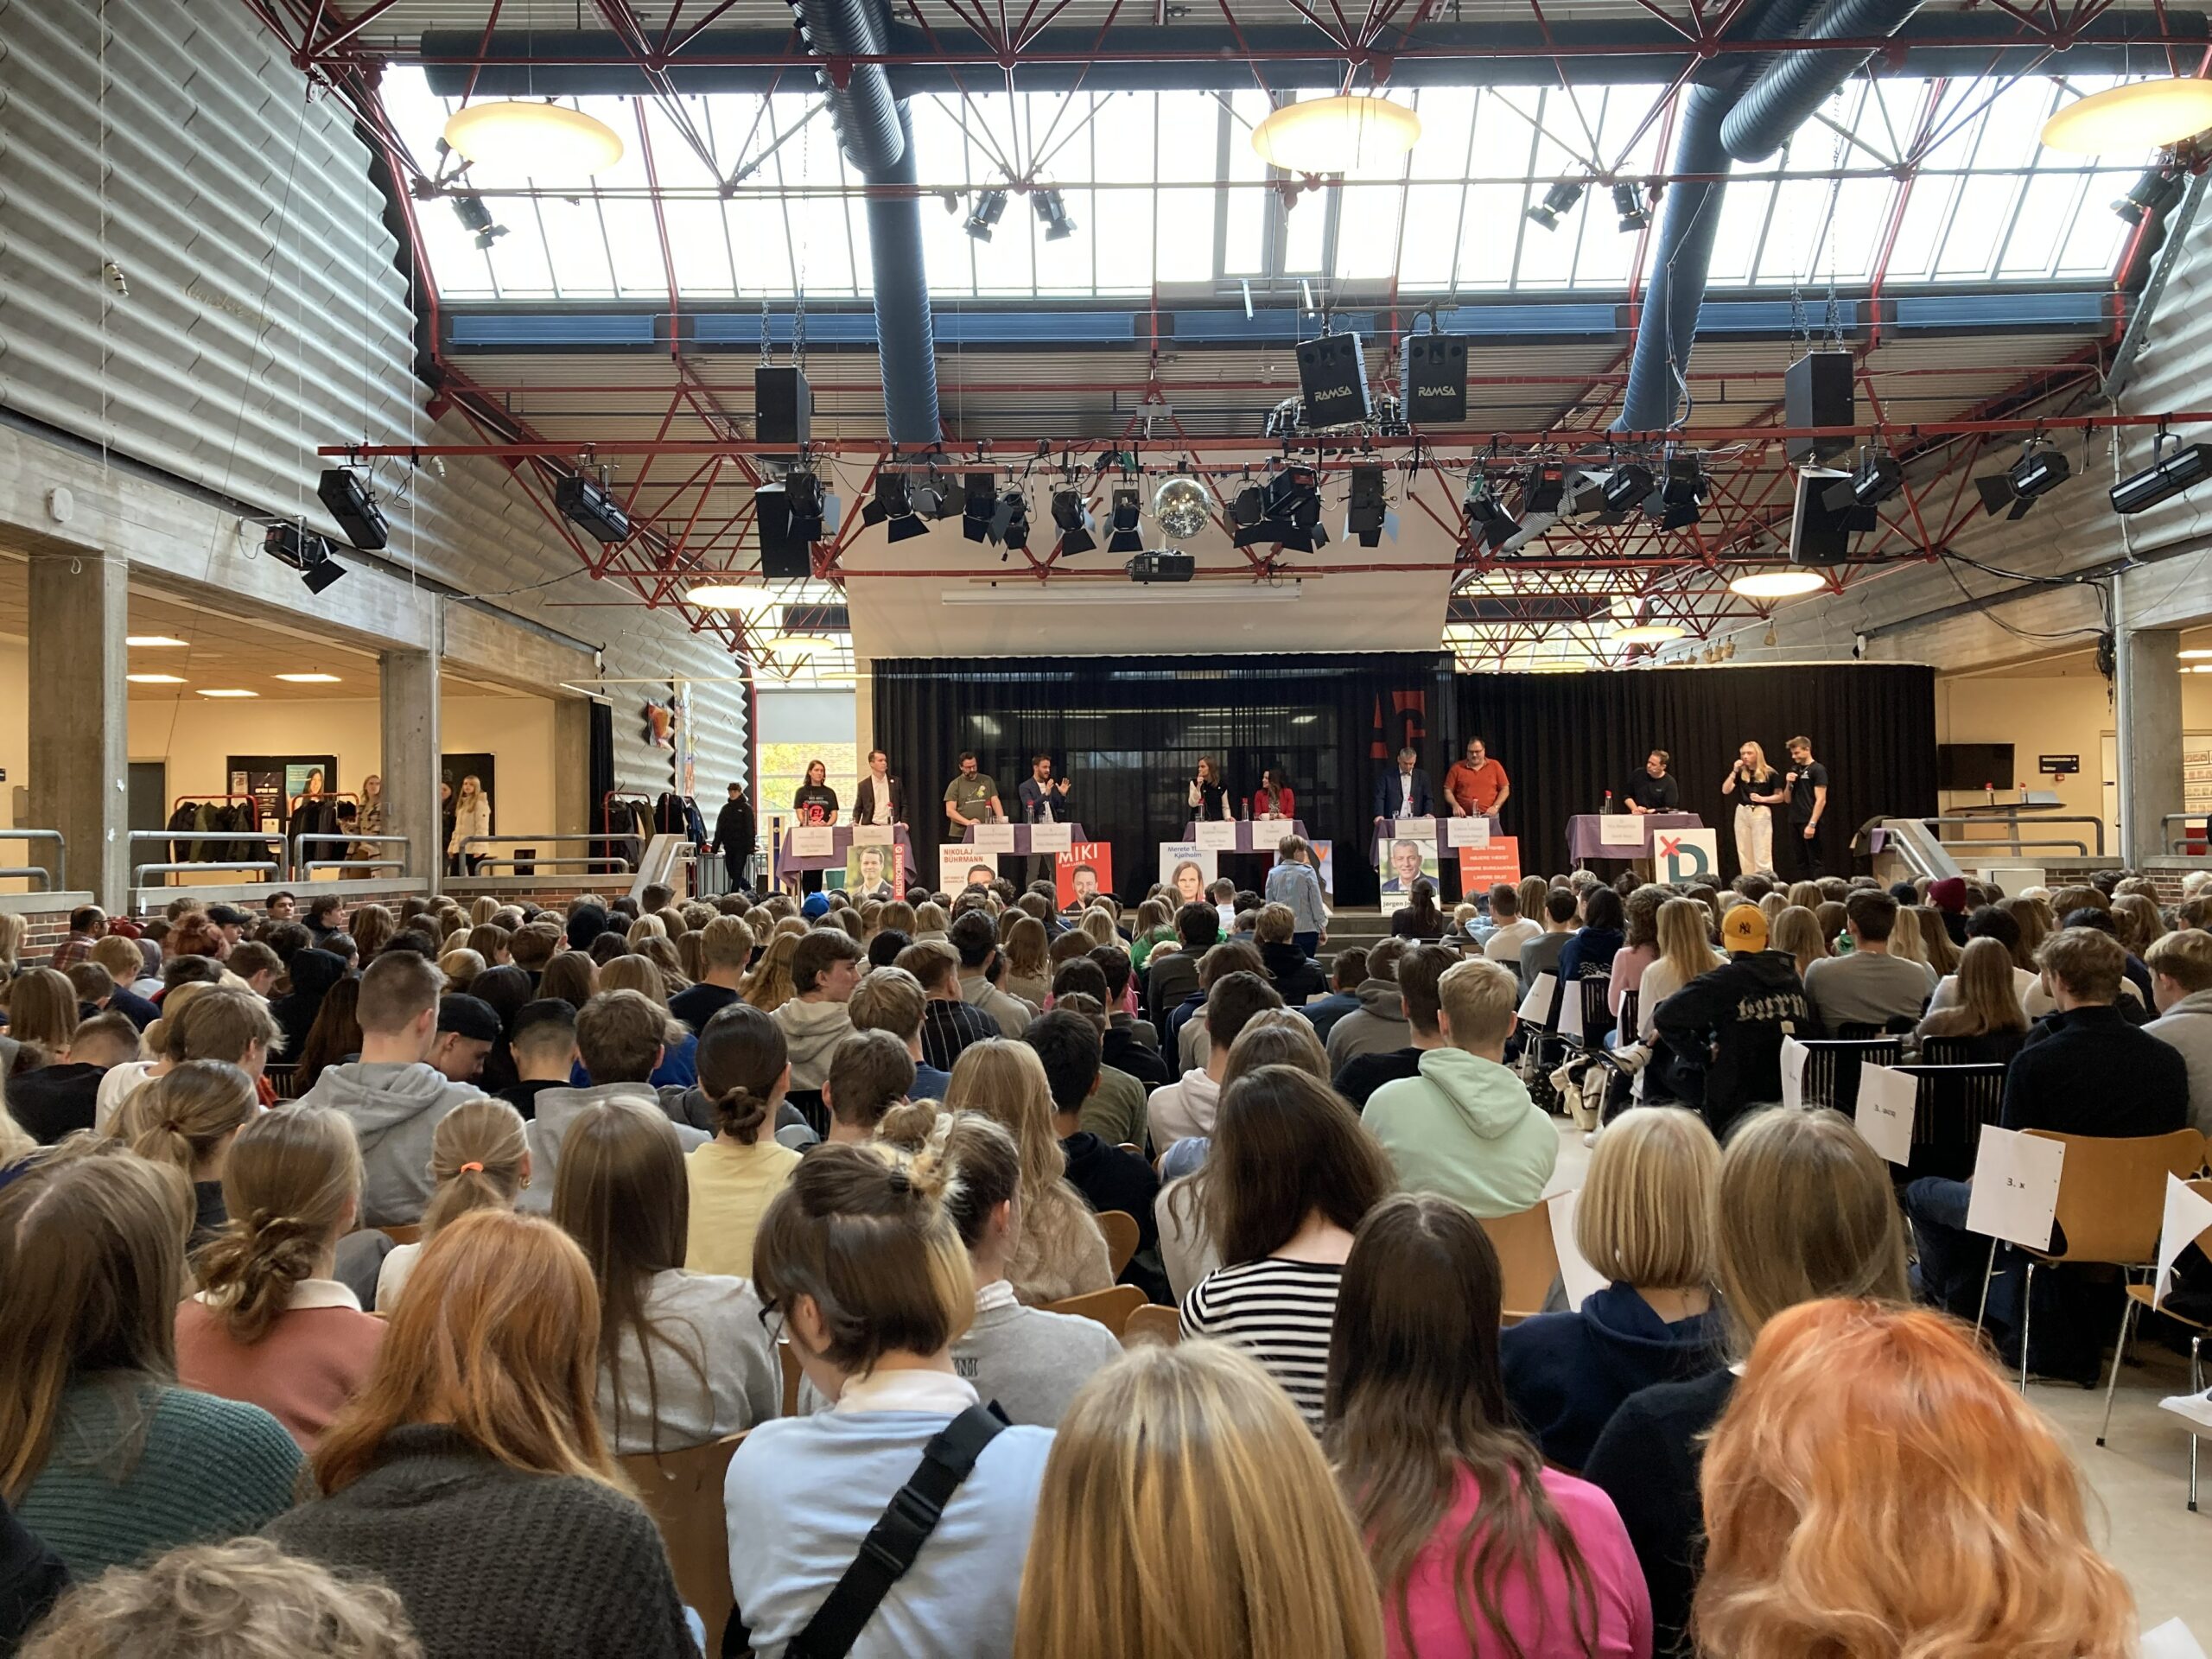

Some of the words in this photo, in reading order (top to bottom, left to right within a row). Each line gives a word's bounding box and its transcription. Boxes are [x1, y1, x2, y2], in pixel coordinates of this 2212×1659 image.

[1314, 385, 1353, 402] RAMSA
[1418, 386, 1456, 397] RAMSA
[1058, 842, 1098, 864] MIKI
[2006, 1177, 2017, 1188] 3.
